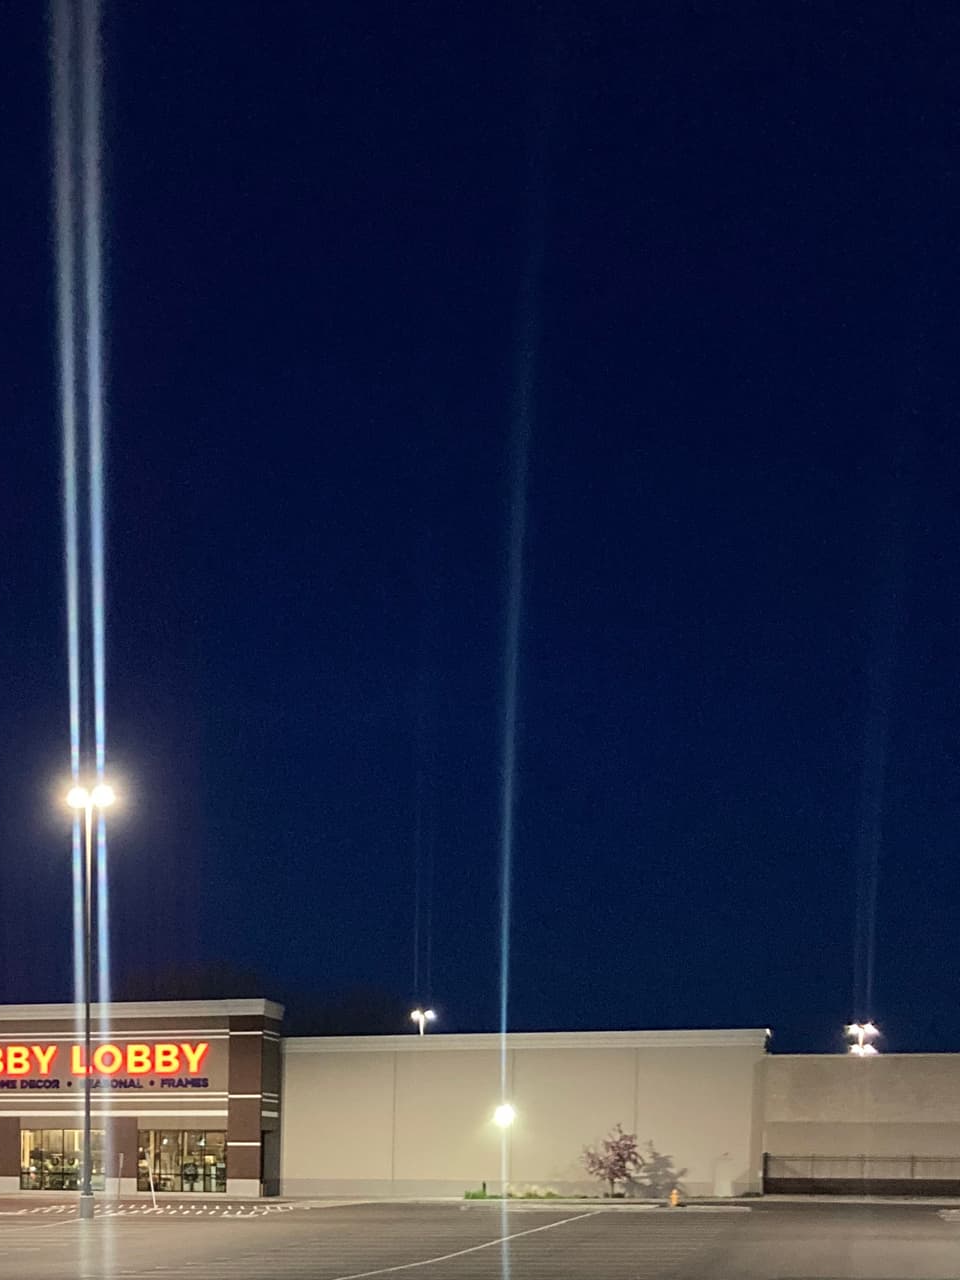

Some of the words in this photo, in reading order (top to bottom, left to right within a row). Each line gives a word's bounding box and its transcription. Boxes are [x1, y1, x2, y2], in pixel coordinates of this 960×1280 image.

[71, 1043, 208, 1074] LOBBY
[20, 1079, 60, 1089] DECOR
[79, 1078, 143, 1088] AONAL
[160, 1077, 209, 1088] FRAMES
